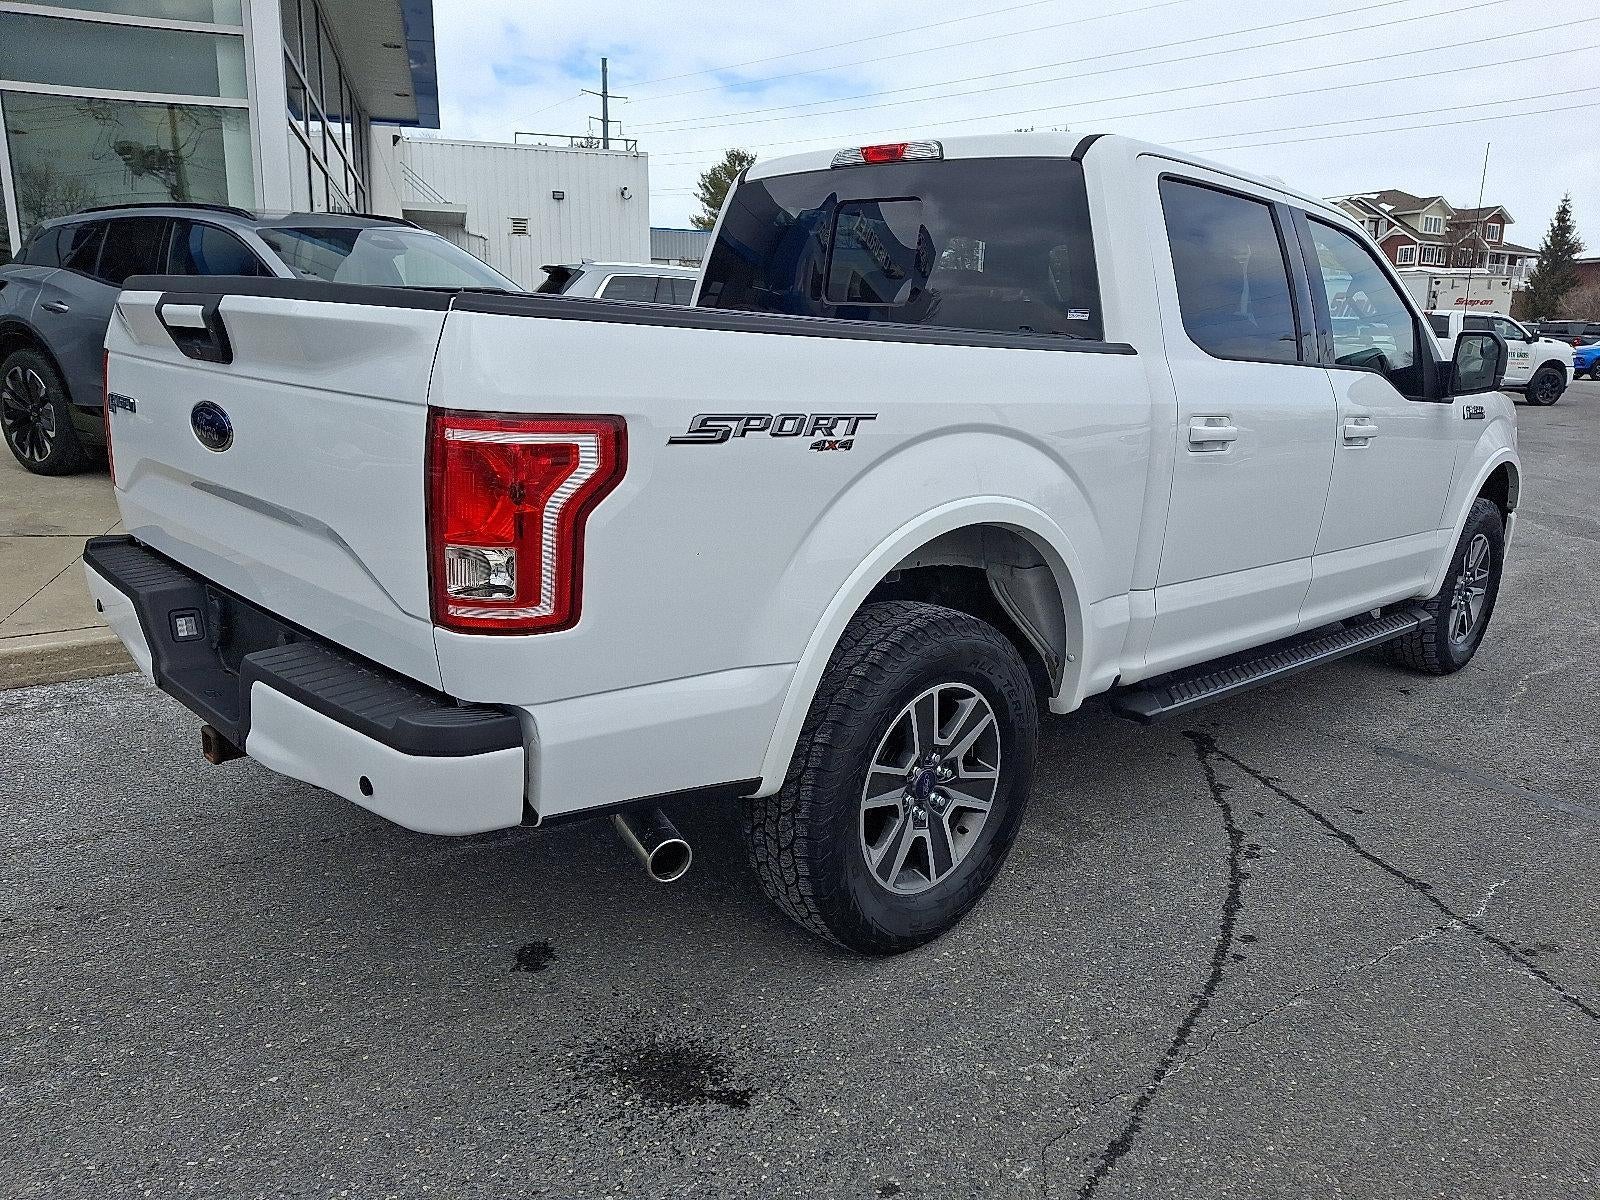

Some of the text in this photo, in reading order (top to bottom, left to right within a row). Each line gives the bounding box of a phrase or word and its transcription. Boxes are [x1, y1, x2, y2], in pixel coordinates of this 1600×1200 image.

[194, 410, 221, 442] Ford
[666, 413, 878, 446] SPORT
[808, 438, 855, 452] 4x4
